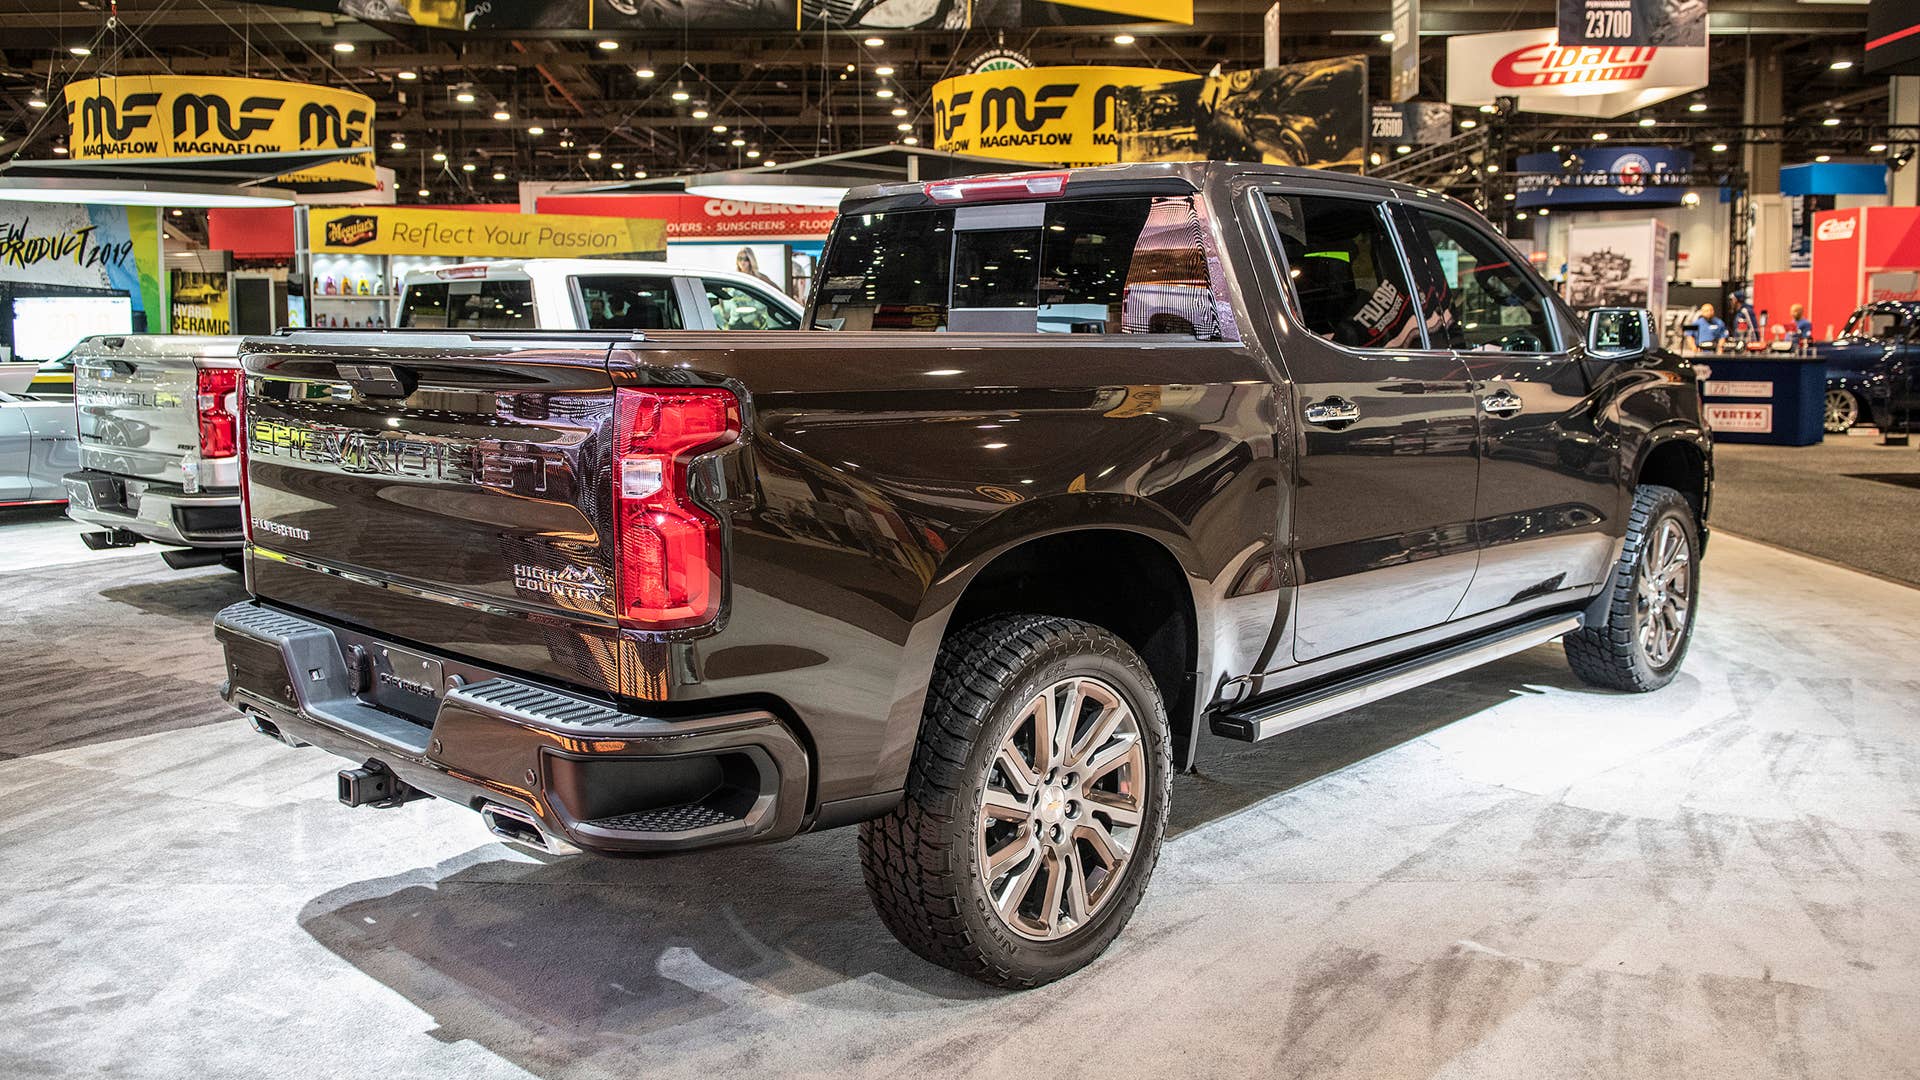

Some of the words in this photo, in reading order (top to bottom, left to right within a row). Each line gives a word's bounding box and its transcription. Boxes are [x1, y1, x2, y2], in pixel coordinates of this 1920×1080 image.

[1585, 10, 1632, 38] 23700
[83, 141, 159, 157] MAGNAFLOW
[173, 141, 281, 154] MAGNAFLOW
[980, 133, 1073, 149] MAGNAFLOW
[328, 218, 374, 242] Meguiar's
[716, 220, 786, 232] SUNSCREENS
[392, 222, 475, 249] Reflect
[484, 225, 531, 245] Your
[538, 227, 618, 247] Passion
[85, 240, 134, 269] 2019
[173, 303, 212, 320] HYBRID
[173, 316, 230, 335] CERAMIC
[1712, 410, 1763, 420] VERTEX
[177, 443, 196, 451] RST
[249, 418, 566, 492] CHEVROLET
[514, 563, 559, 580] HIGH
[515, 577, 605, 602] COUNTRY
